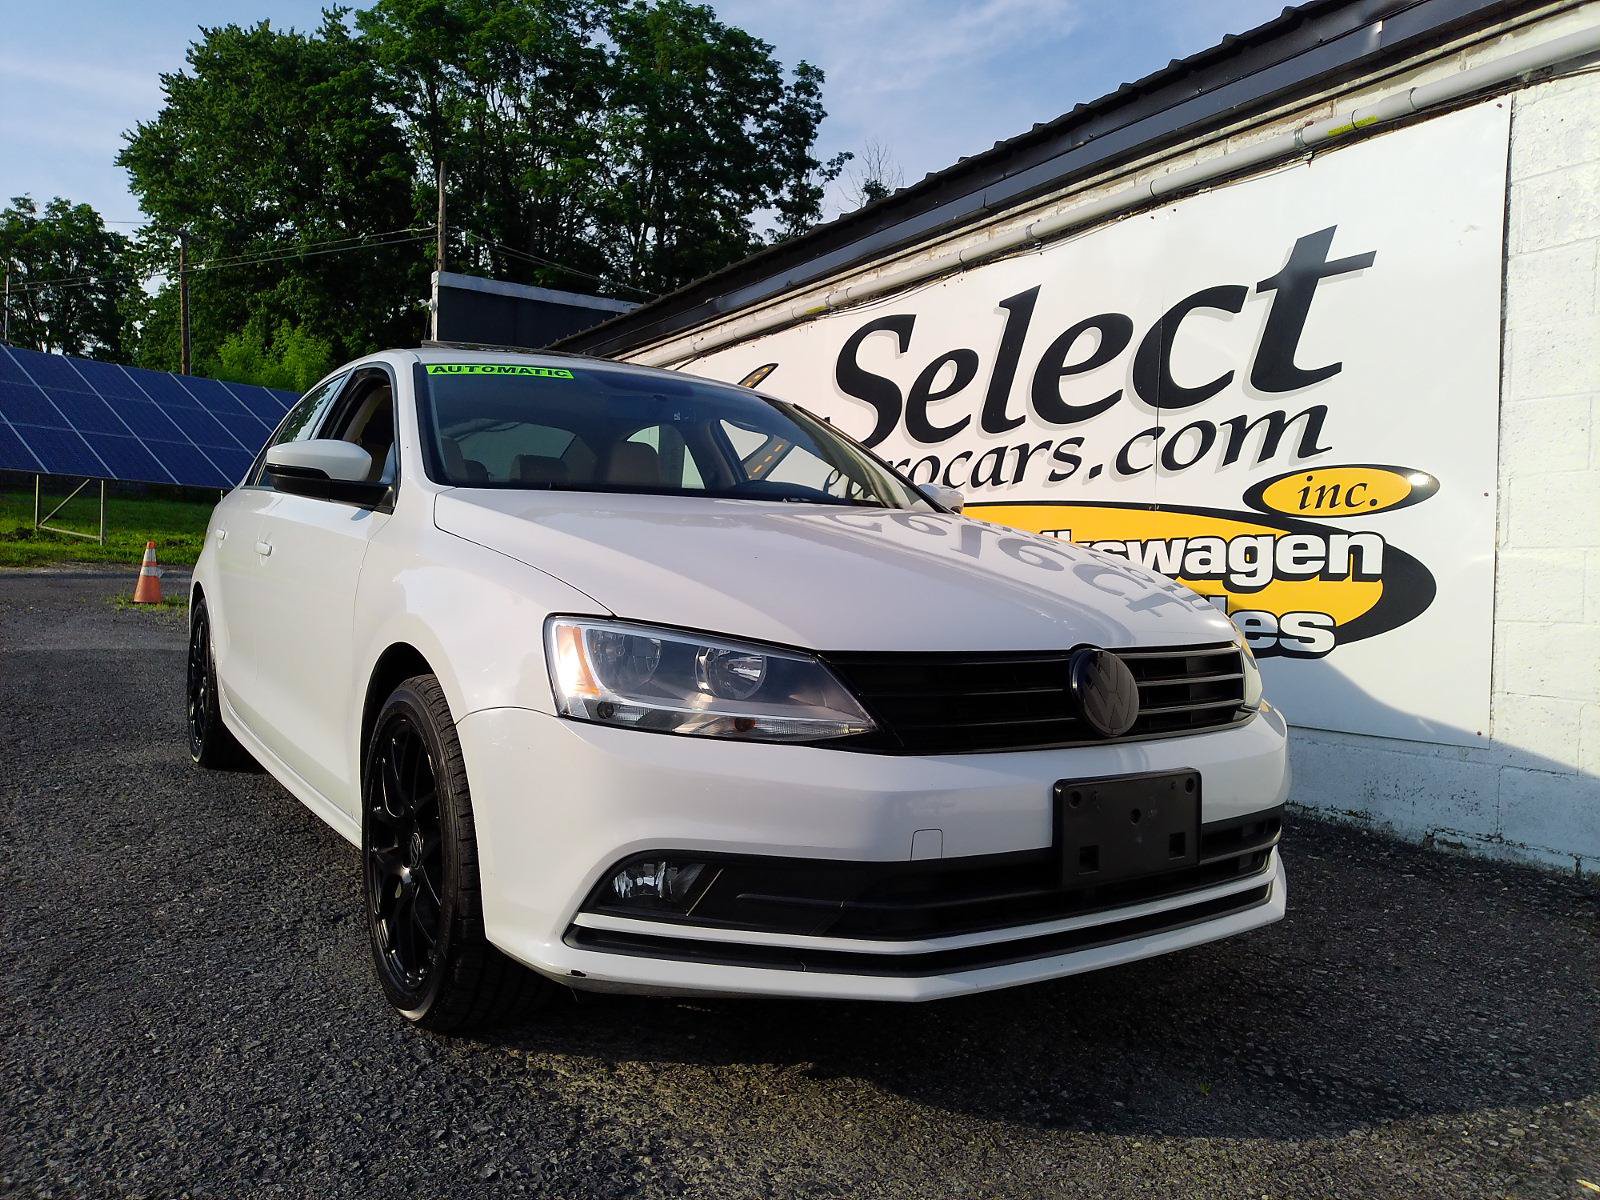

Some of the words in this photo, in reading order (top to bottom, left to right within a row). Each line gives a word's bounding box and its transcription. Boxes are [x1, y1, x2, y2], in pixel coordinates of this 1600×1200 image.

[835, 224, 1377, 449] Select
[432, 365, 568, 377] AUTOMATIC
[1297, 475, 1378, 510] inc.
